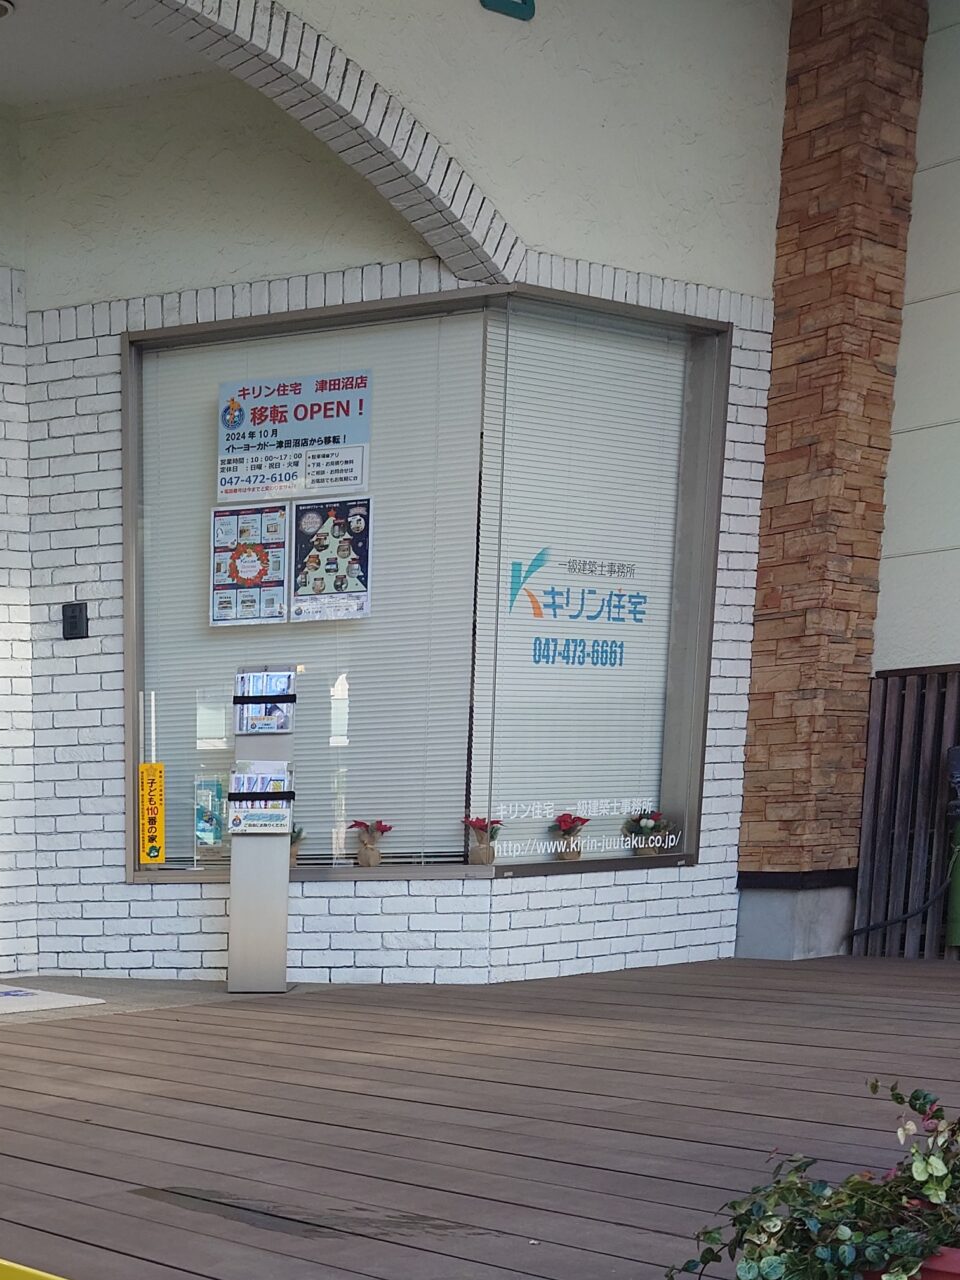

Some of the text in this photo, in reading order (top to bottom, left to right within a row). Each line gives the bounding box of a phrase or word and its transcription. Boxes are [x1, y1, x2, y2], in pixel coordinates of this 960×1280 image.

[238, 375, 368, 401] キリン住宅 津田沼店
[250, 404, 288, 426] 移転
[220, 471, 299, 487] 047-472-6106
[558, 558, 636, 579] 一級建築士事務所
[542, 587, 648, 624] キリン住宅
[532, 636, 625, 667] 047-473-6661
[146, 778, 159, 843] 子ども110番の家
[495, 797, 654, 820] キリン住宅 一級建築士事務所
[494, 830, 682, 857] http://www.kirin-juutaku.co.jp/
